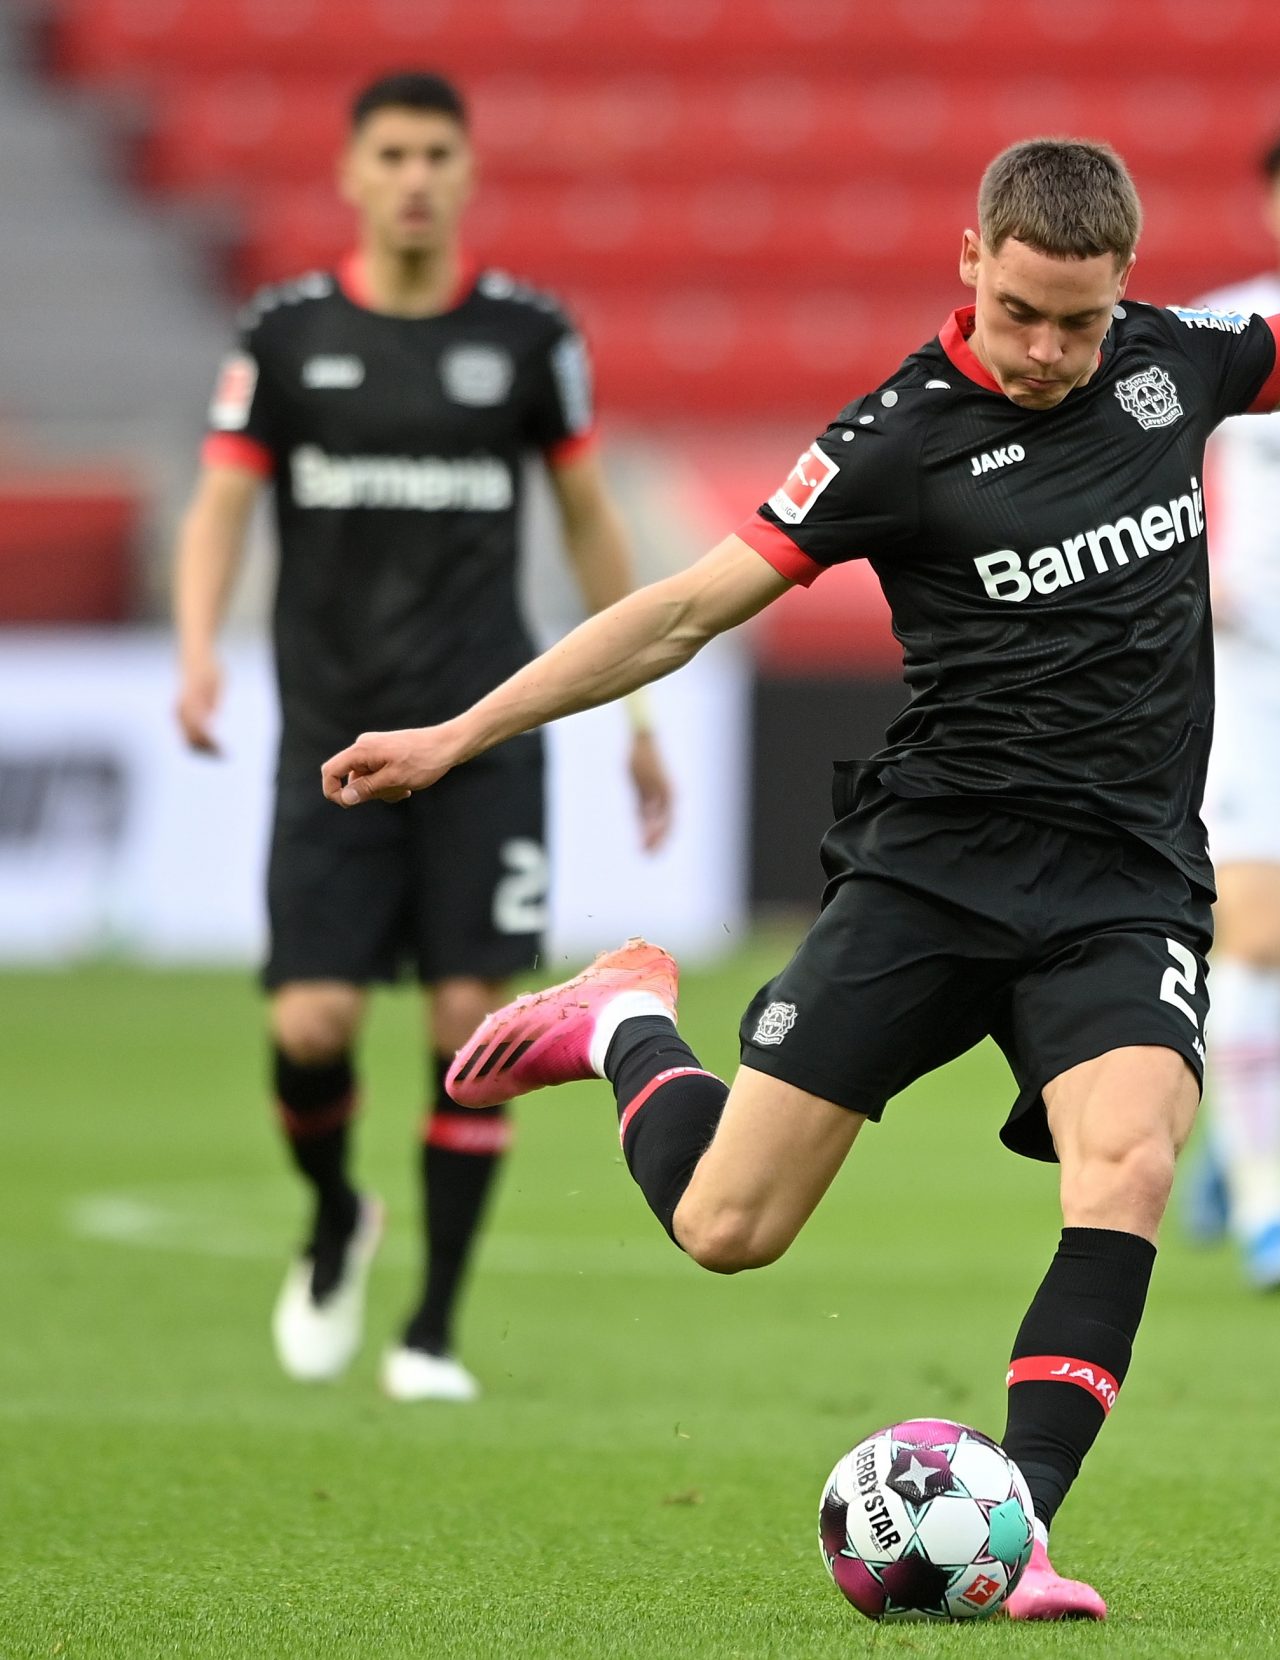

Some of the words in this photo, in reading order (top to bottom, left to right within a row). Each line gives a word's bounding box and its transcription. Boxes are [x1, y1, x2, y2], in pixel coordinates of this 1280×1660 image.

[971, 444, 1026, 477] JAKO
[1159, 937, 1199, 1030] 2
[1050, 1363, 1116, 1409] JAKO
